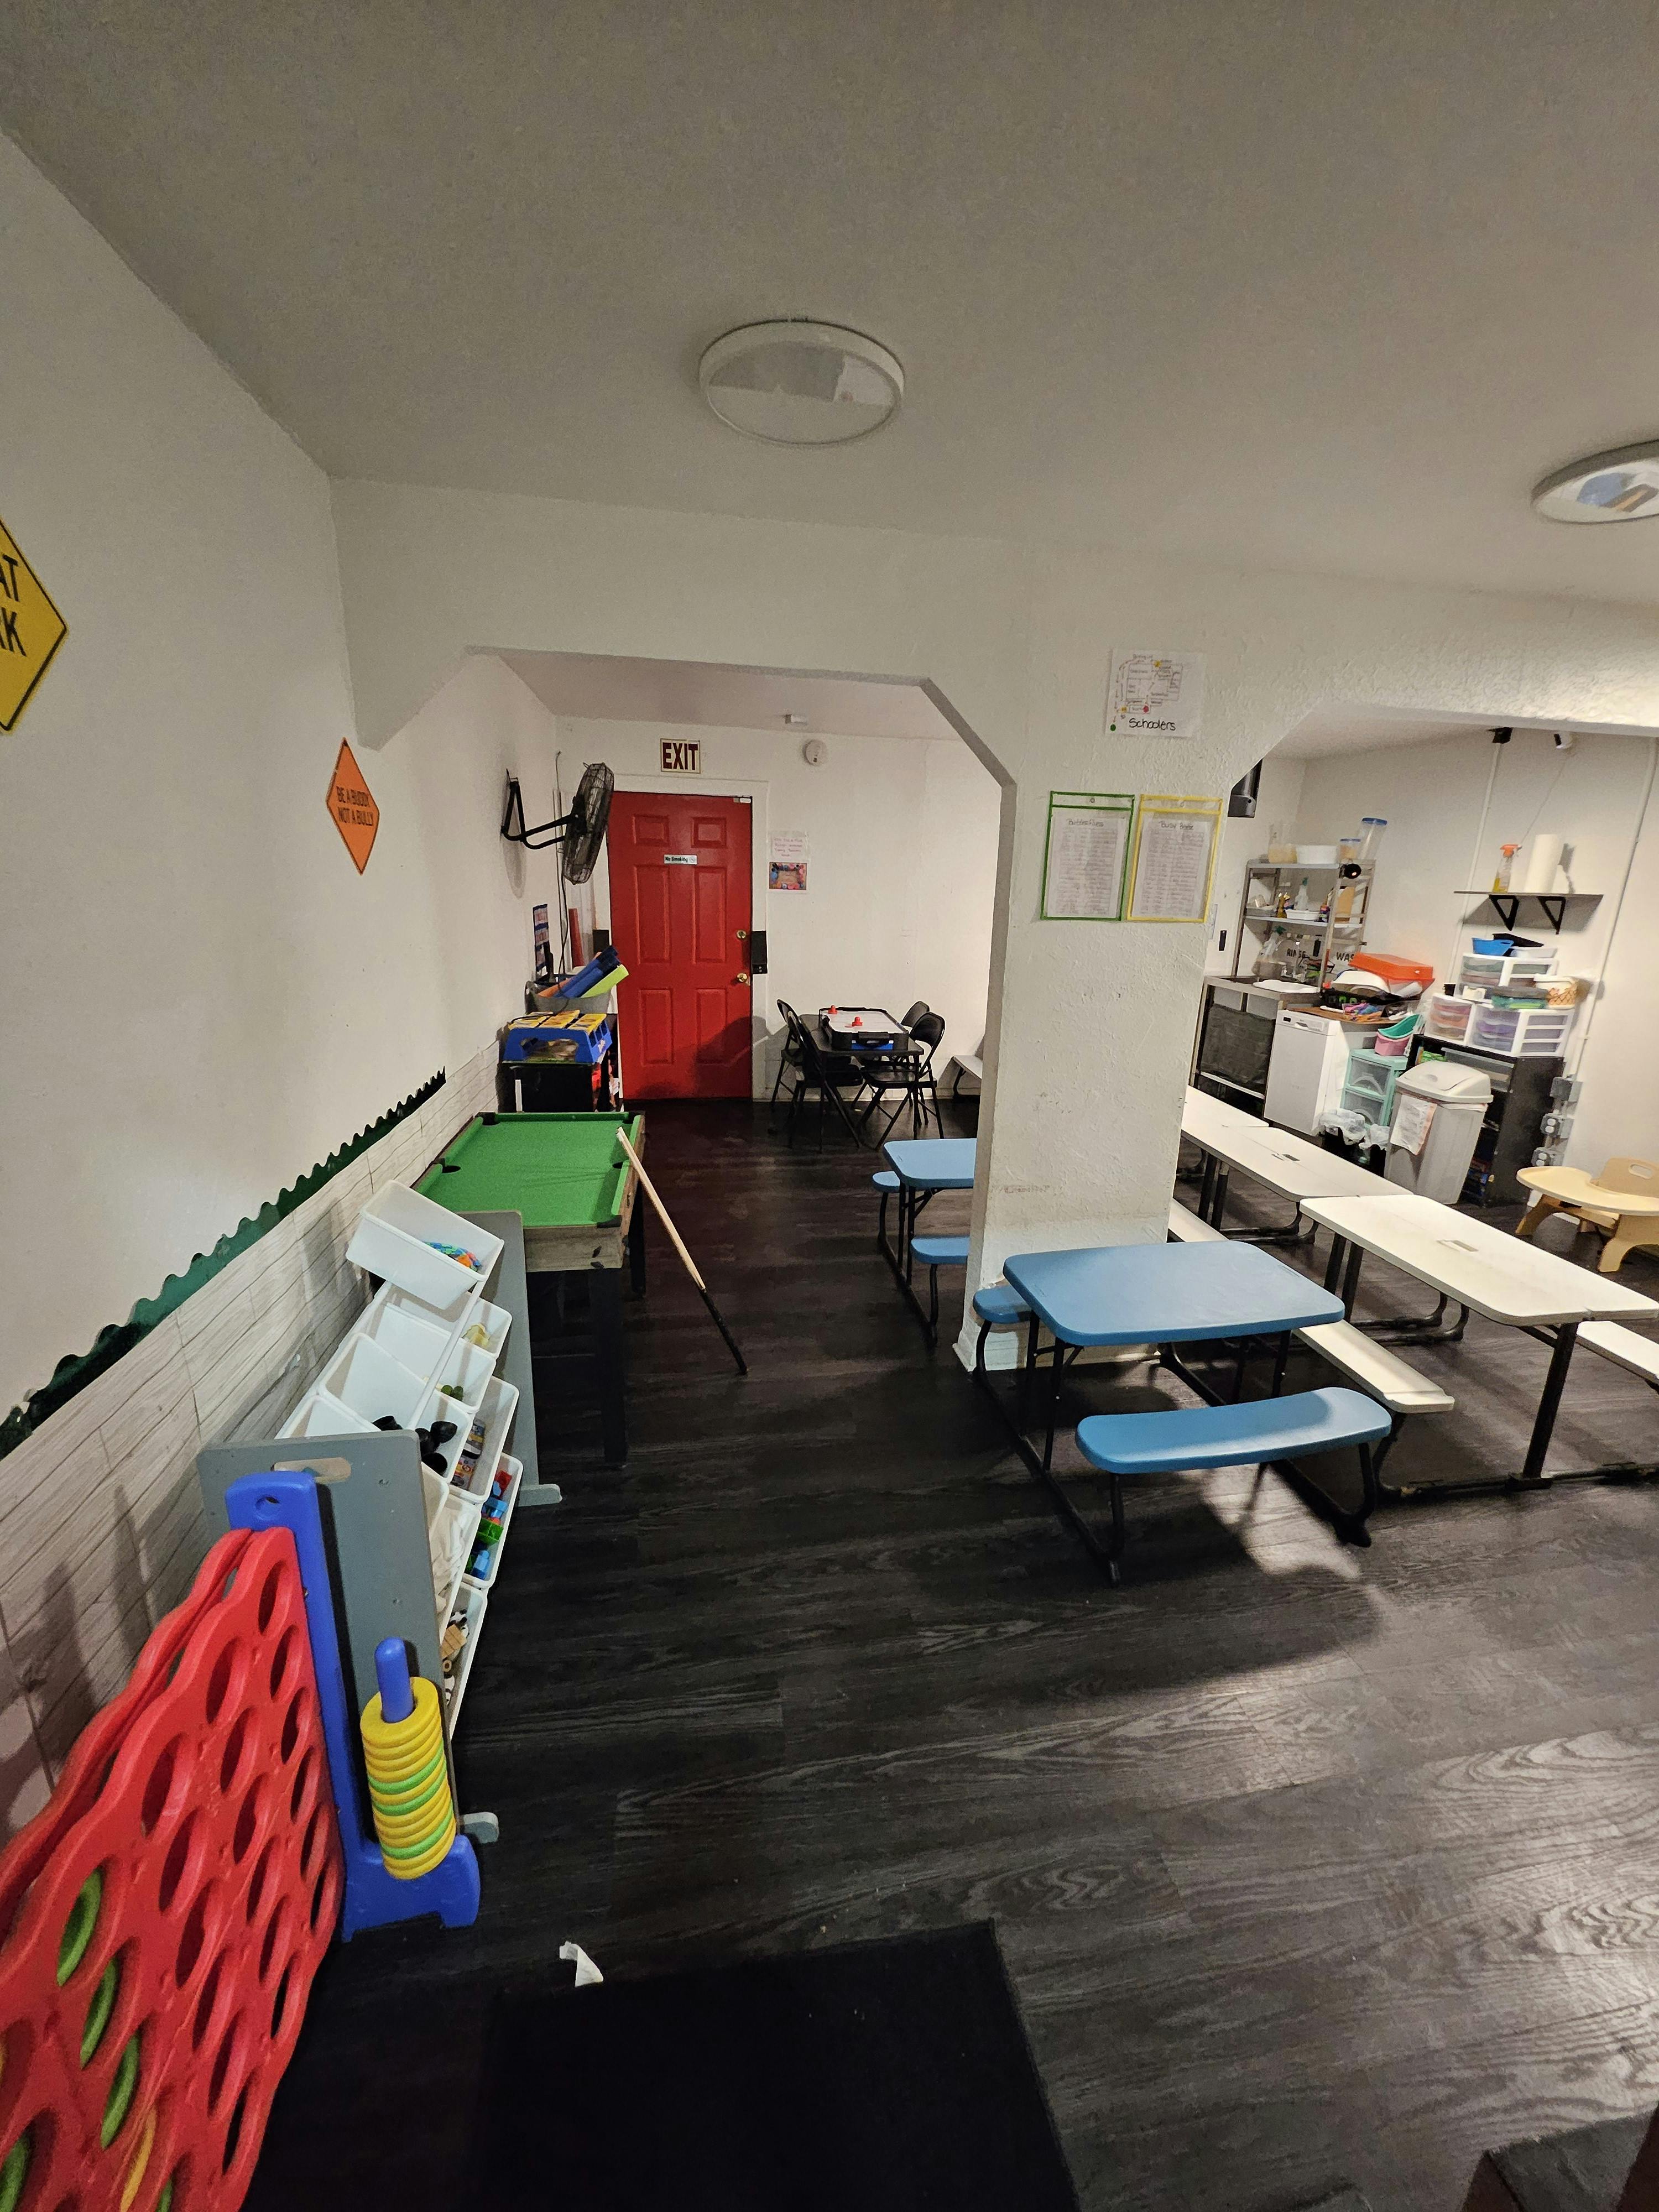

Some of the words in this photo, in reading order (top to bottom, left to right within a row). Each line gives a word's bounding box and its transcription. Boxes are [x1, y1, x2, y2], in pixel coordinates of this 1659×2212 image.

[1129, 718, 1176, 731] Schoolers
[662, 742, 698, 770] EXIT
[336, 786, 346, 804] BE
[346, 789, 350, 803] A
[351, 789, 370, 807] BUDDY
[337, 806, 350, 823] NOT
[351, 809, 357, 825] A
[357, 810, 373, 827] BULLY
[1336, 952, 1354, 962] WAS
